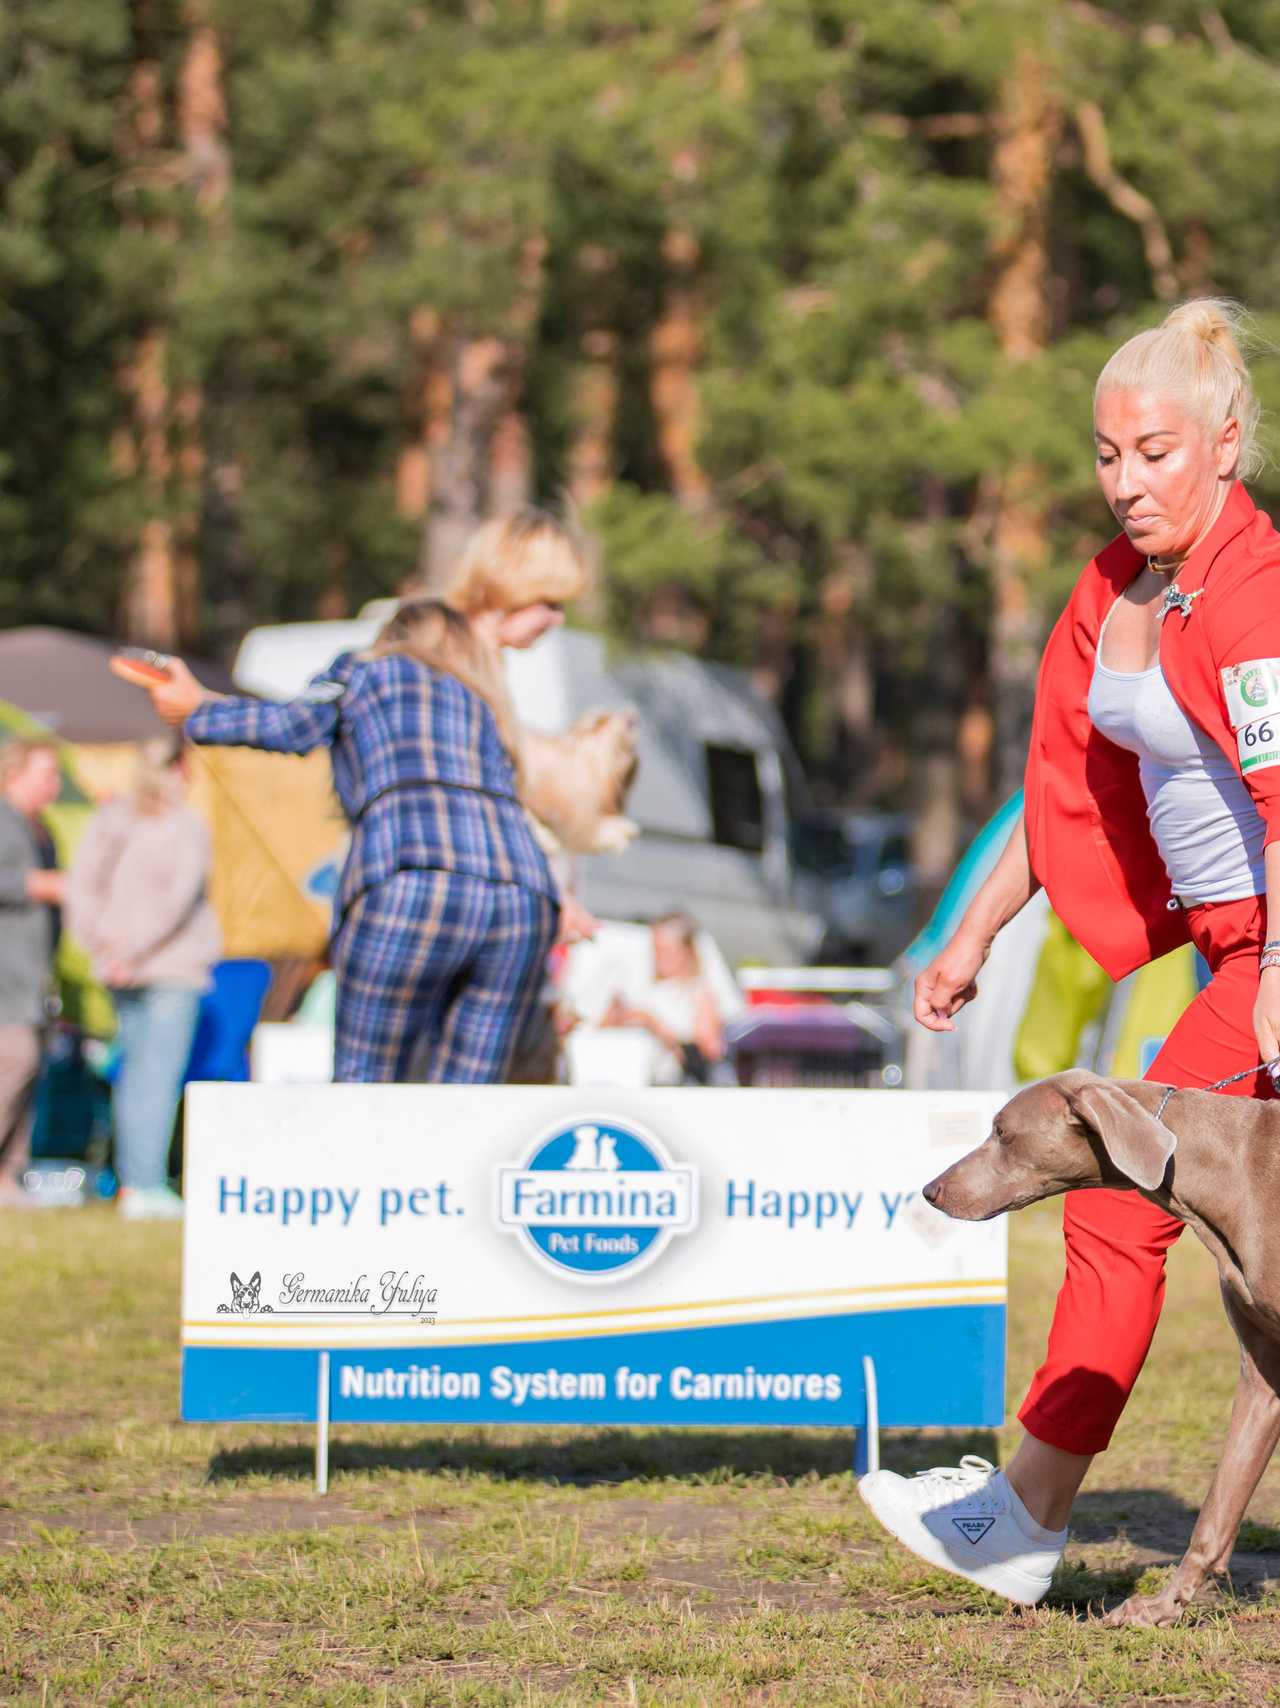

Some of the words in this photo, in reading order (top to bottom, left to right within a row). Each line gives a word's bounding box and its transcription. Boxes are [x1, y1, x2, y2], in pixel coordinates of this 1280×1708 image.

[219, 1177, 358, 1225] Happy
[381, 1183, 463, 1226] pet.
[514, 1179, 675, 1216] Farmina
[727, 1180, 862, 1229] Happy
[548, 1232, 580, 1254] Pet
[584, 1232, 639, 1255] Foods
[341, 1365, 480, 1398] Nutrition
[491, 1366, 605, 1406] System
[615, 1367, 661, 1399] for
[671, 1367, 841, 1400] Carnivores
